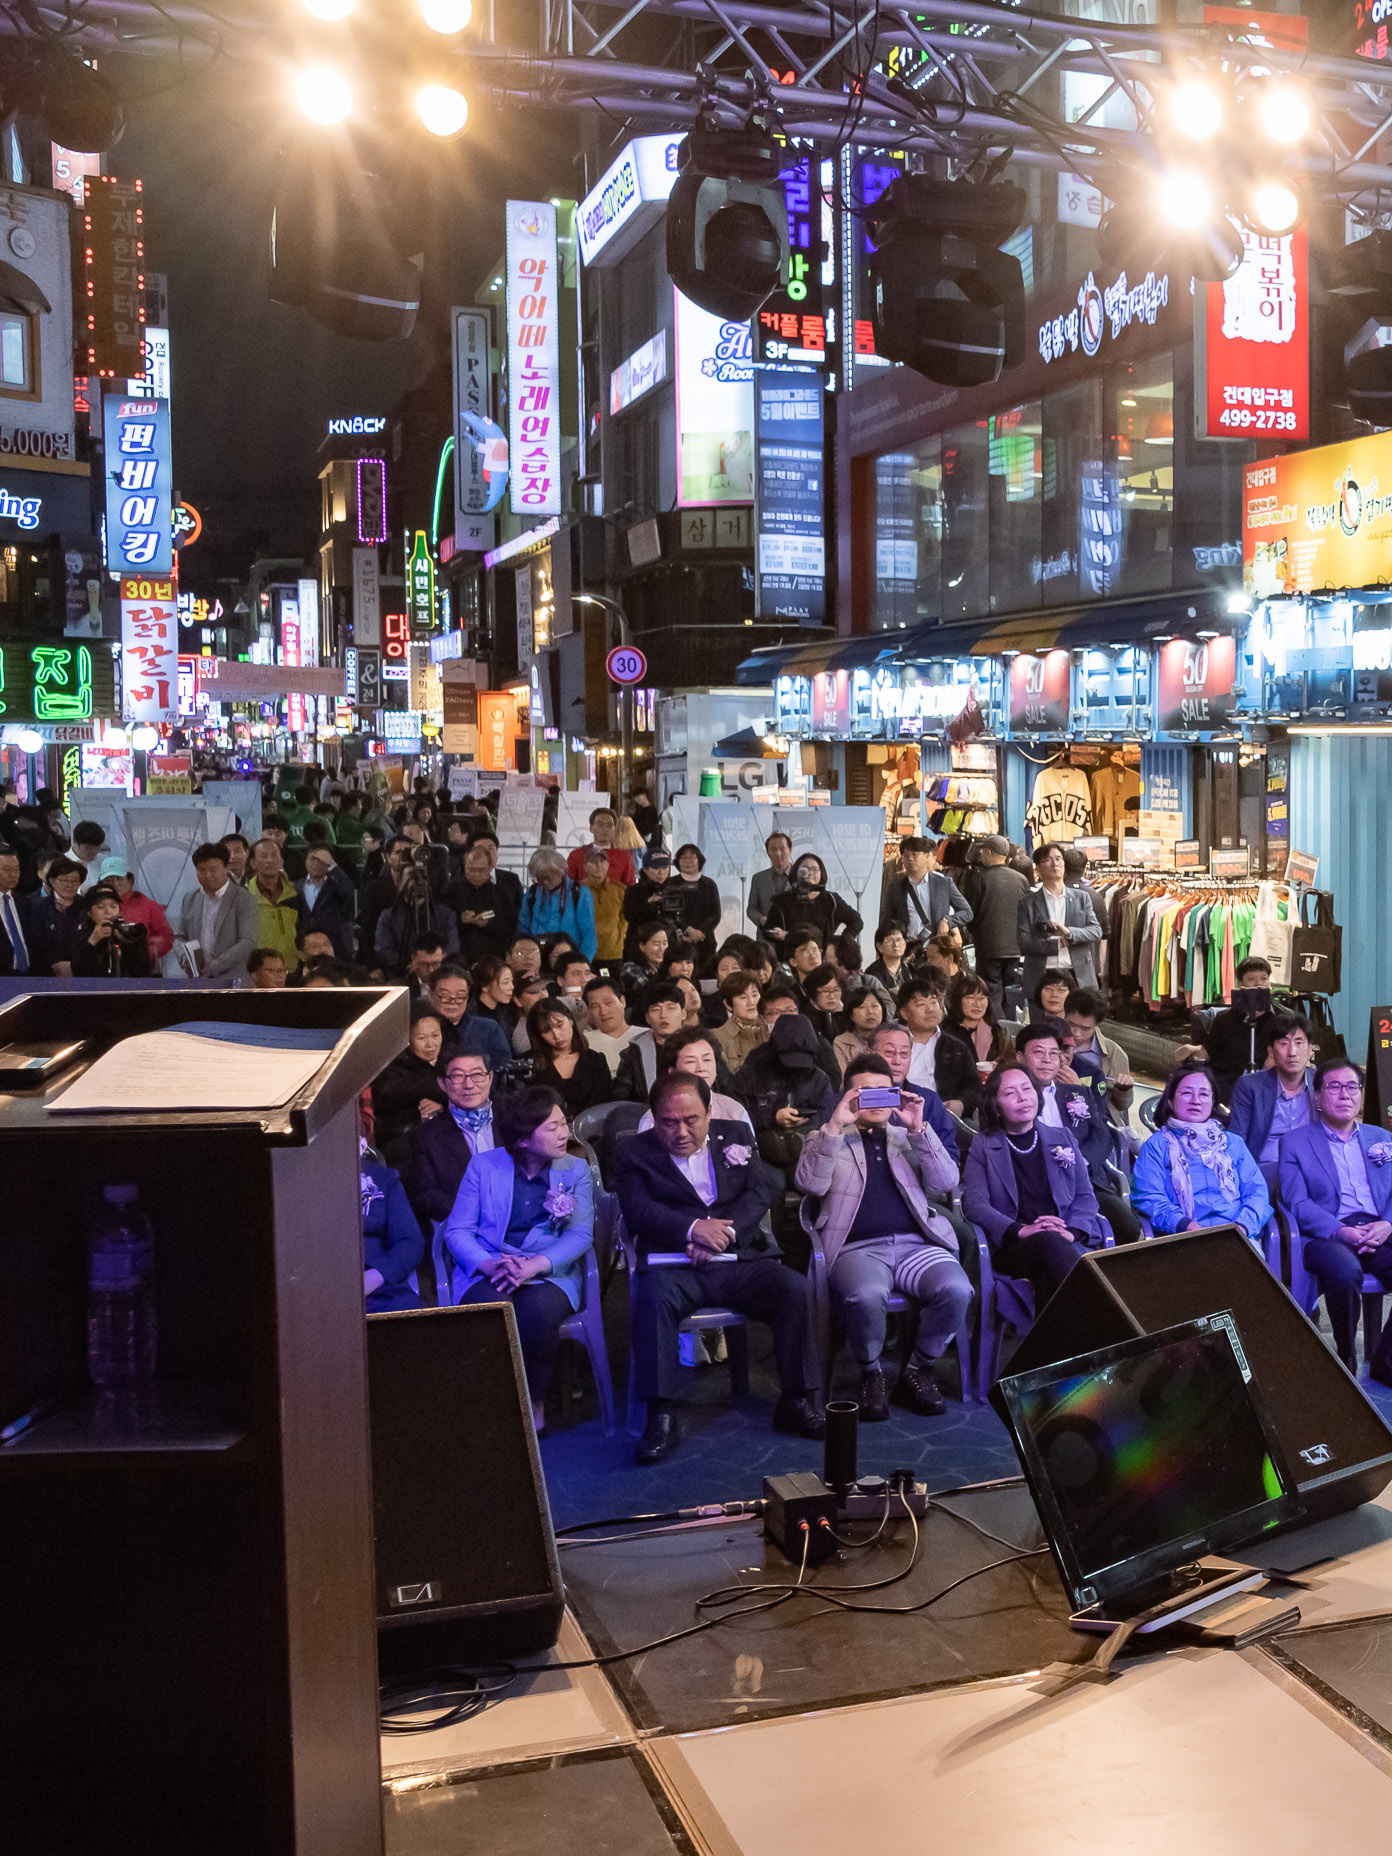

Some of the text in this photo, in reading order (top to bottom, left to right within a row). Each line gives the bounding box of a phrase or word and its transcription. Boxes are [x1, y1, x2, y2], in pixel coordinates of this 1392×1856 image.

[761, 312, 825, 351] 커플룸
[766, 341, 788, 360] 3F
[517, 258, 552, 505] 악어떼 노래연습장
[1223, 386, 1293, 407] 건대입구점
[123, 403, 153, 414] fun
[1219, 409, 1296, 431] 499-2738
[119, 422, 160, 564] 펀비어킹
[469, 527, 482, 537] 2F
[126, 580, 173, 600] 30년
[414, 557, 430, 624] 시민호프
[126, 607, 173, 709] 닭갈비
[616, 658, 636, 673] 30
[1182, 645, 1208, 685] 50
[346, 651, 356, 696] COFFEE
[1025, 657, 1044, 693] 50
[1025, 704, 1047, 724] SALE
[1181, 698, 1209, 721] SALE
